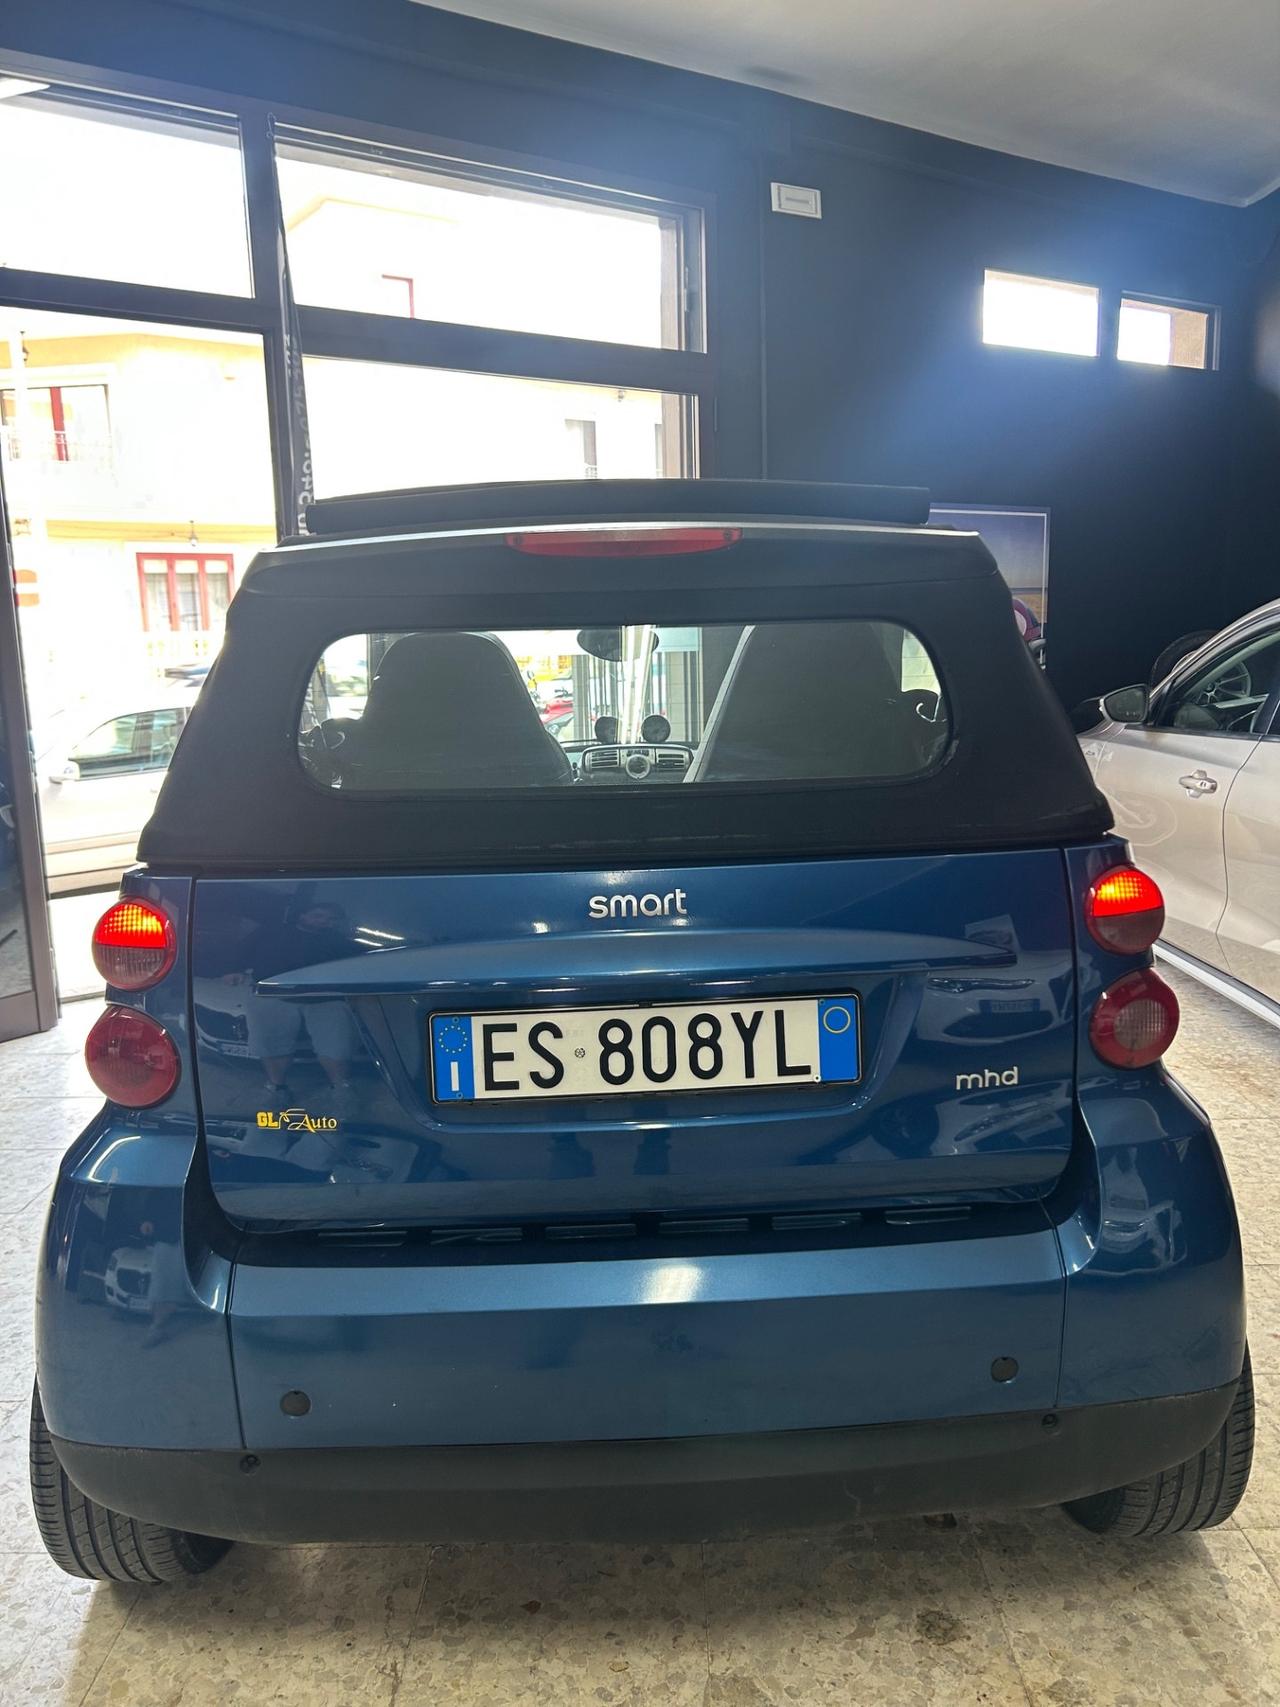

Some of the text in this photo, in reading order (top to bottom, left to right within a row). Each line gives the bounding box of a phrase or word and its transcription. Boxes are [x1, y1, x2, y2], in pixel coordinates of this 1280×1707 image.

[588, 888, 688, 919] smart
[483, 1009, 812, 1091] ES 808YL
[956, 1066, 1019, 1090] mhd
[256, 1111, 338, 1133] GL Auto
